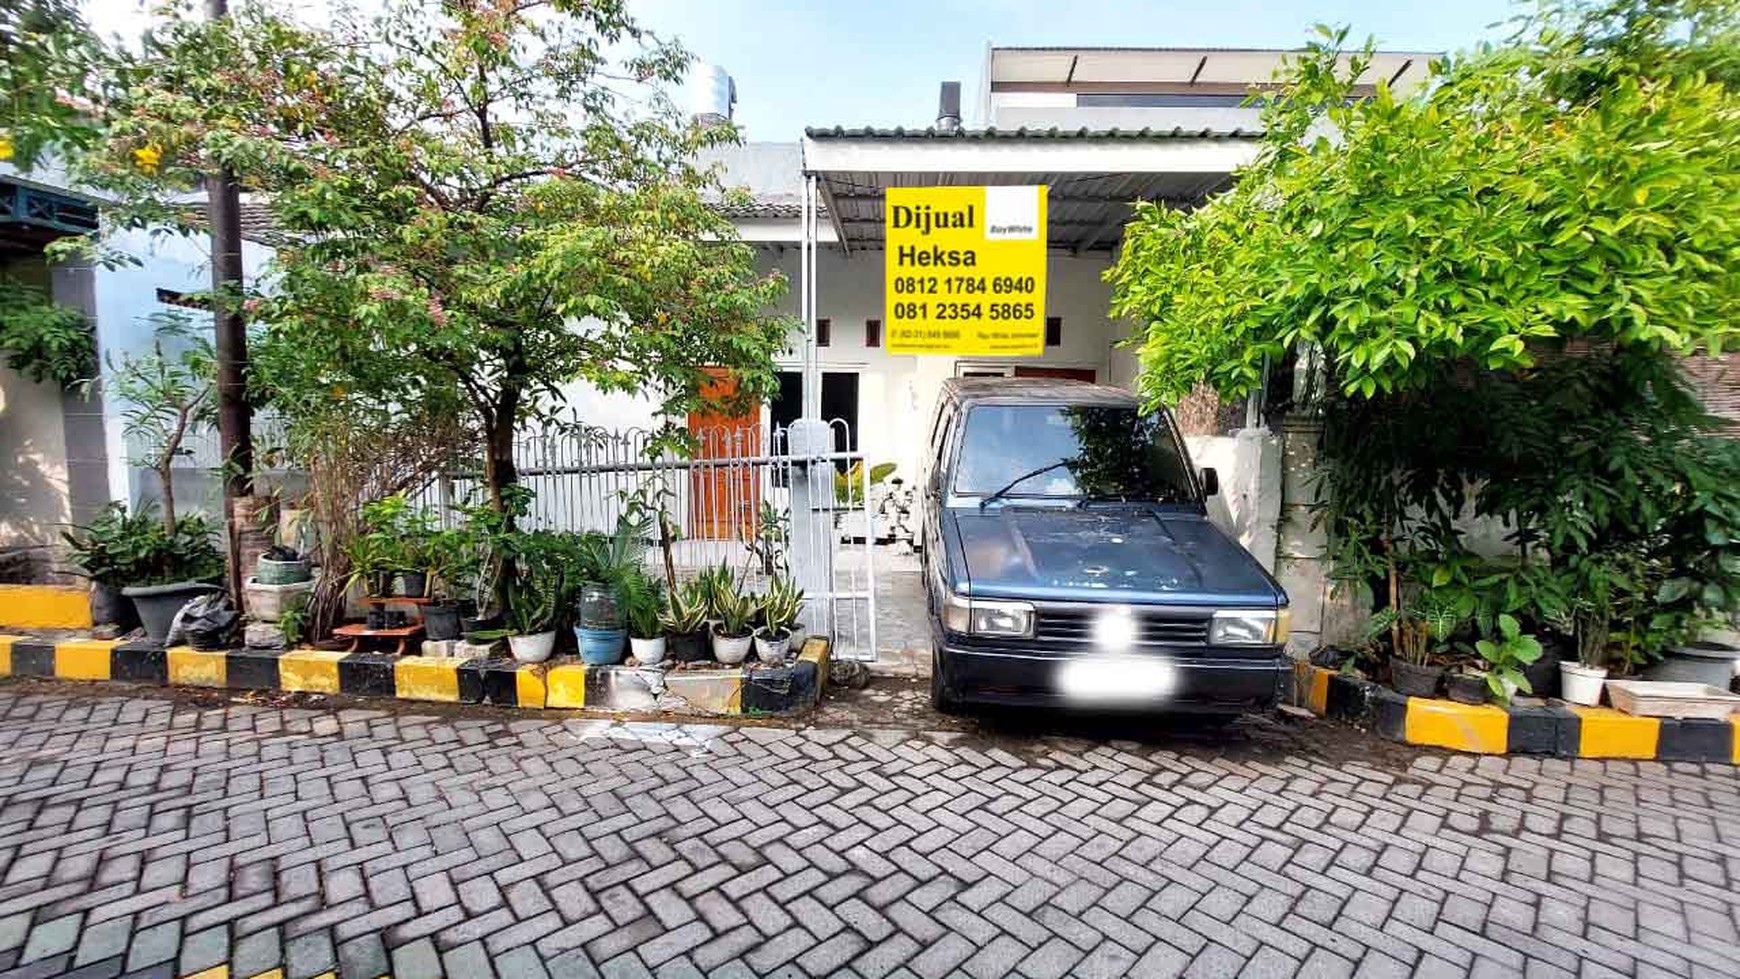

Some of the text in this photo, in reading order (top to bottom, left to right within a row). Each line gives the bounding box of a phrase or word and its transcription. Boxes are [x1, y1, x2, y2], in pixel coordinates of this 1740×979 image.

[892, 205, 975, 235] Dijual
[898, 244, 977, 266] Heksa
[894, 277, 1035, 294] 0812 1784 6940
[894, 302, 1034, 320] 081 2354 5865
